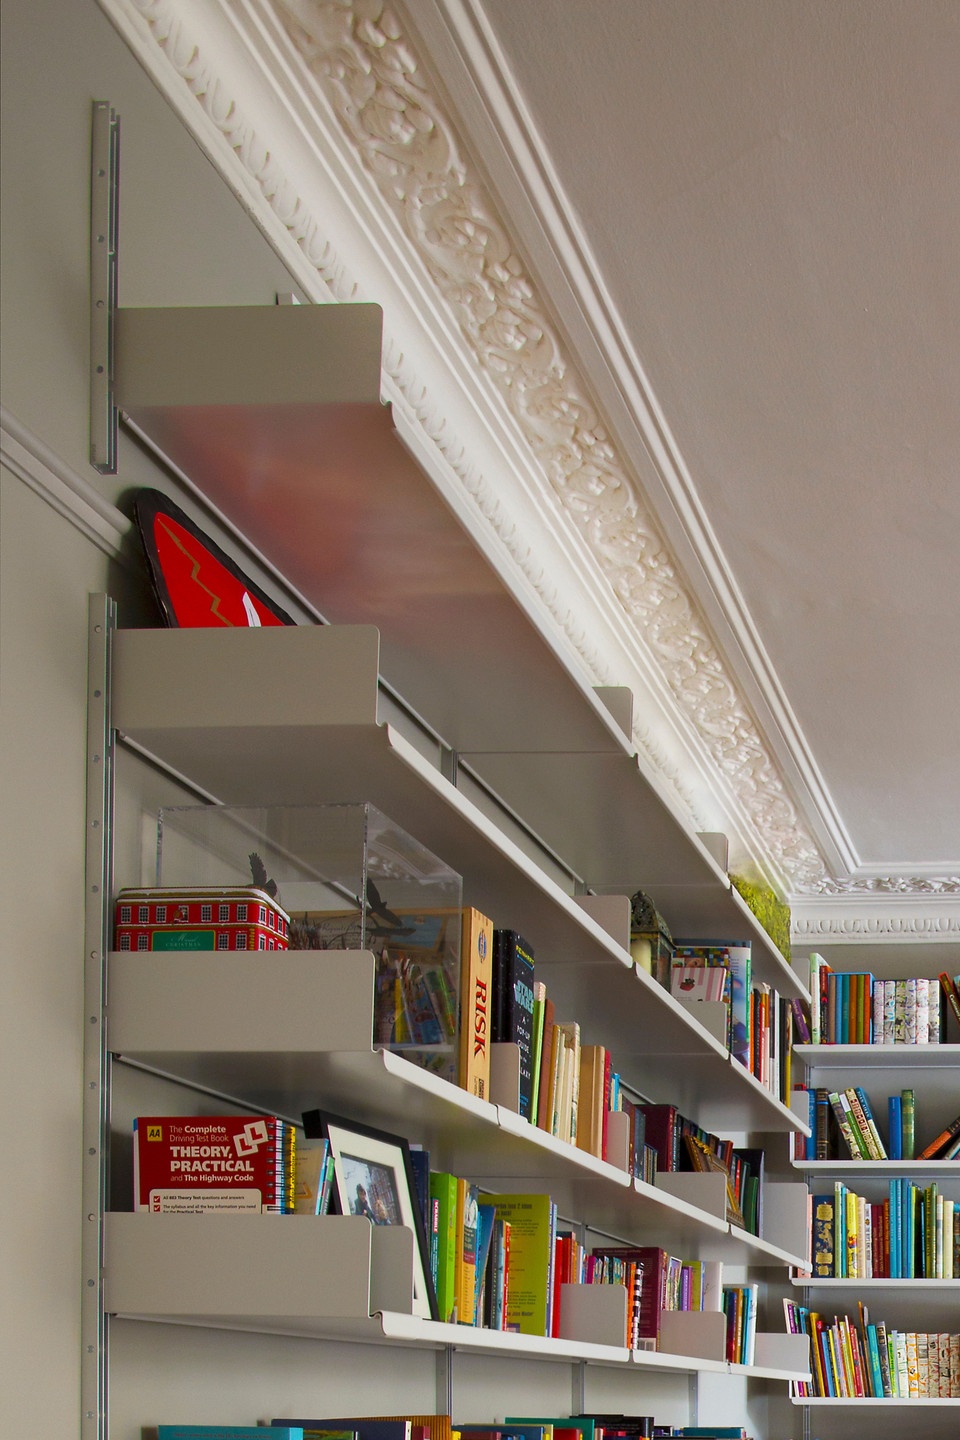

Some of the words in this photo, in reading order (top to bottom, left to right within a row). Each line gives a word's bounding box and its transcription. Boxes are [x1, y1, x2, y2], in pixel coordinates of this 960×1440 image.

[474, 977, 488, 1060] RISK
[148, 1129, 161, 1138] AA
[169, 1125, 183, 1133] The
[184, 1125, 227, 1137] Complete
[169, 1134, 195, 1144] Driving
[195, 1134, 210, 1142] Test
[210, 1134, 229, 1142] Book
[169, 1145, 233, 1159] THEORY,
[170, 1160, 255, 1172] PRACTICAL
[184, 1174, 199, 1182] The
[199, 1174, 233, 1183] Highway
[234, 1174, 254, 1182] Code
